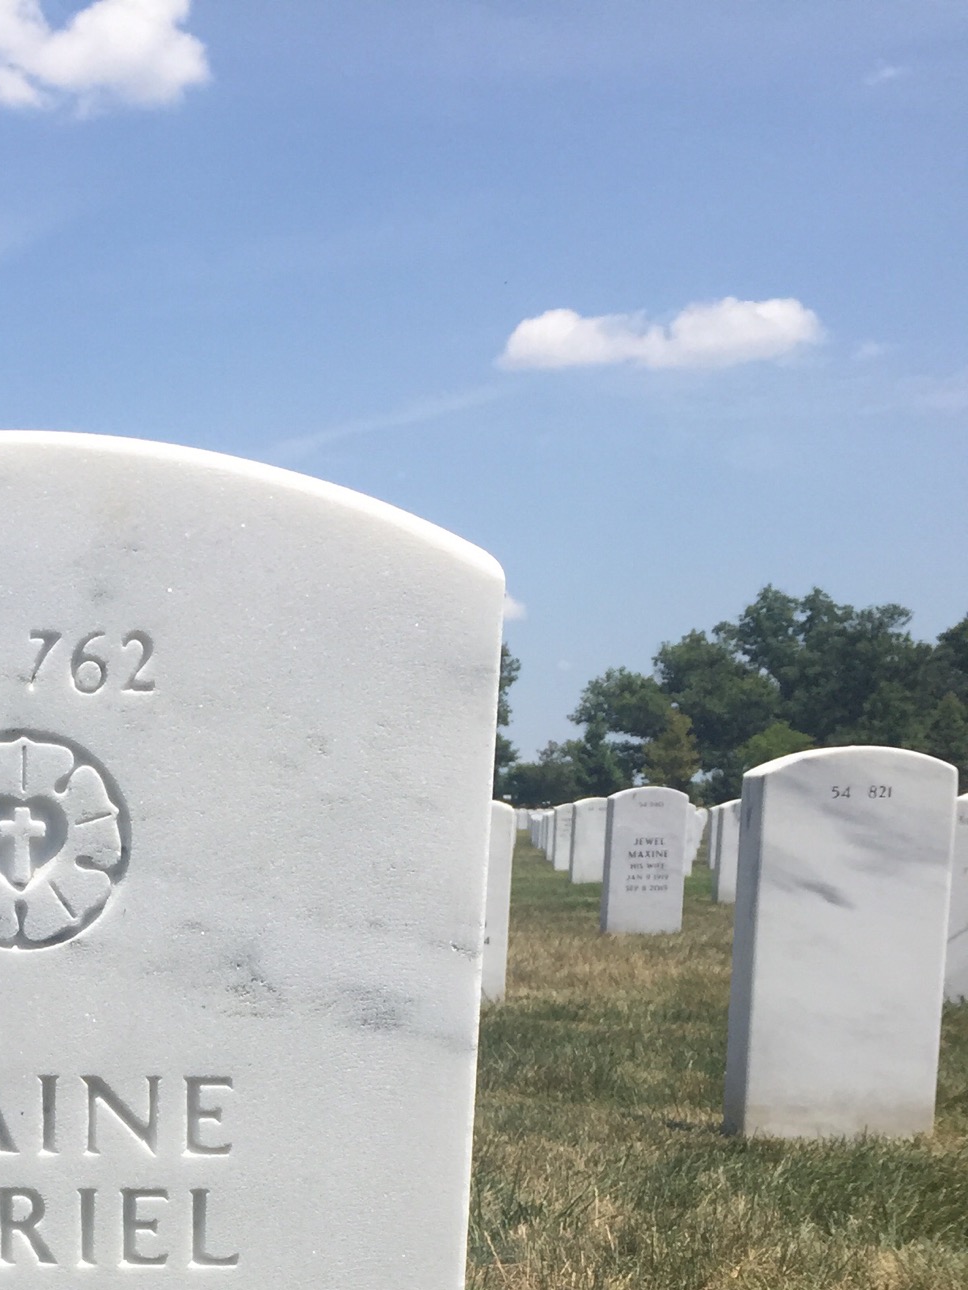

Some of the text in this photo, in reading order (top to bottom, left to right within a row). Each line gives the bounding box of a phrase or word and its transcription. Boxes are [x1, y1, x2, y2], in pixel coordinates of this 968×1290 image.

[28, 629, 156, 694] 762
[831, 785, 893, 799] 54 821
[633, 837, 665, 846] JEWEL
[628, 850, 669, 859] MAXINE
